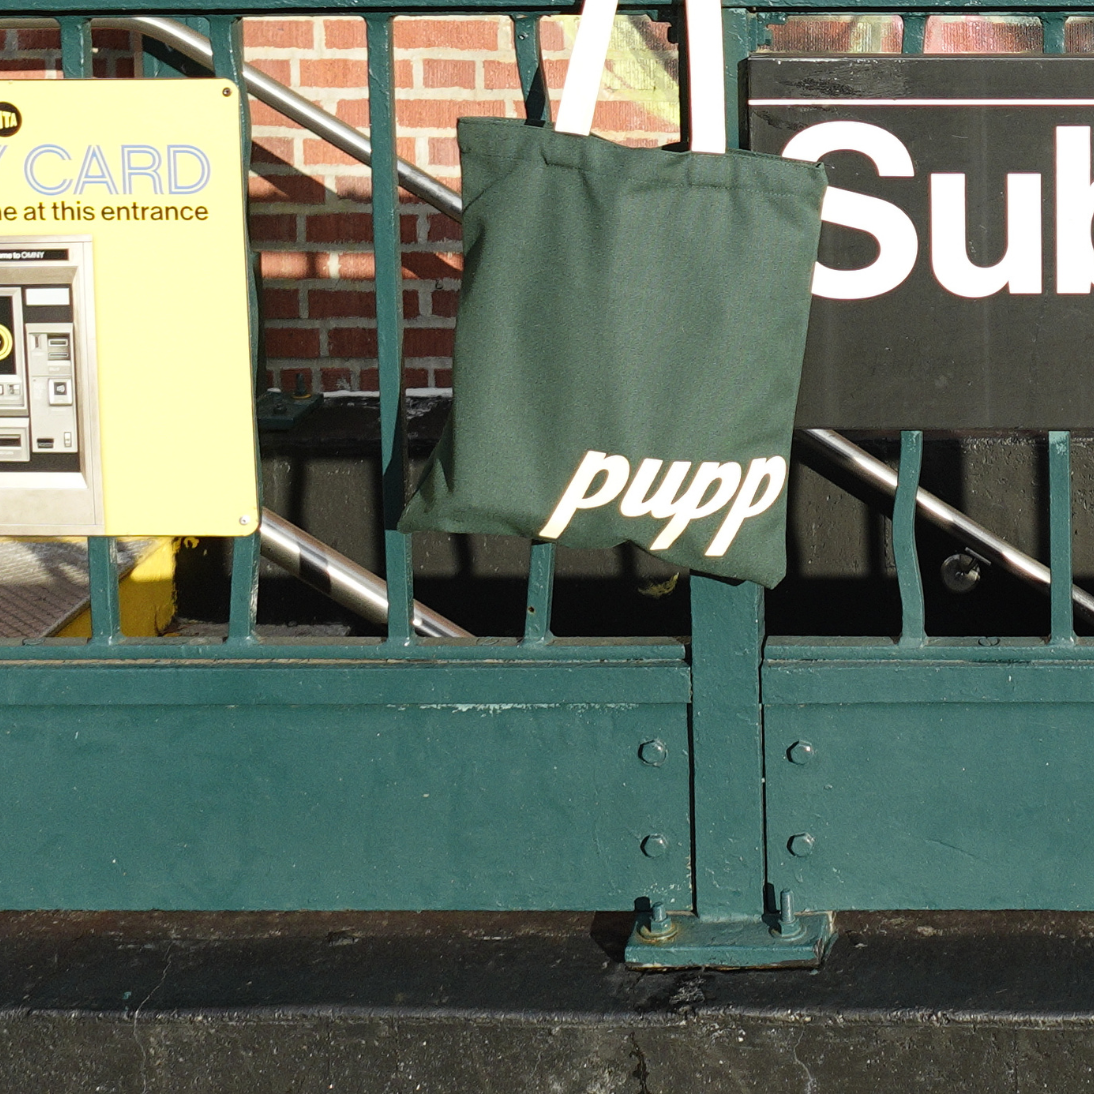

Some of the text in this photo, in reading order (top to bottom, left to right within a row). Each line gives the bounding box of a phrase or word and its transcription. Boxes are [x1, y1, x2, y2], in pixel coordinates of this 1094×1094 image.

[23, 143, 211, 196] CARD
[23, 202, 47, 221] at
[51, 201, 96, 221] this
[101, 202, 209, 221] entrance
[538, 449, 788, 557] pupp
